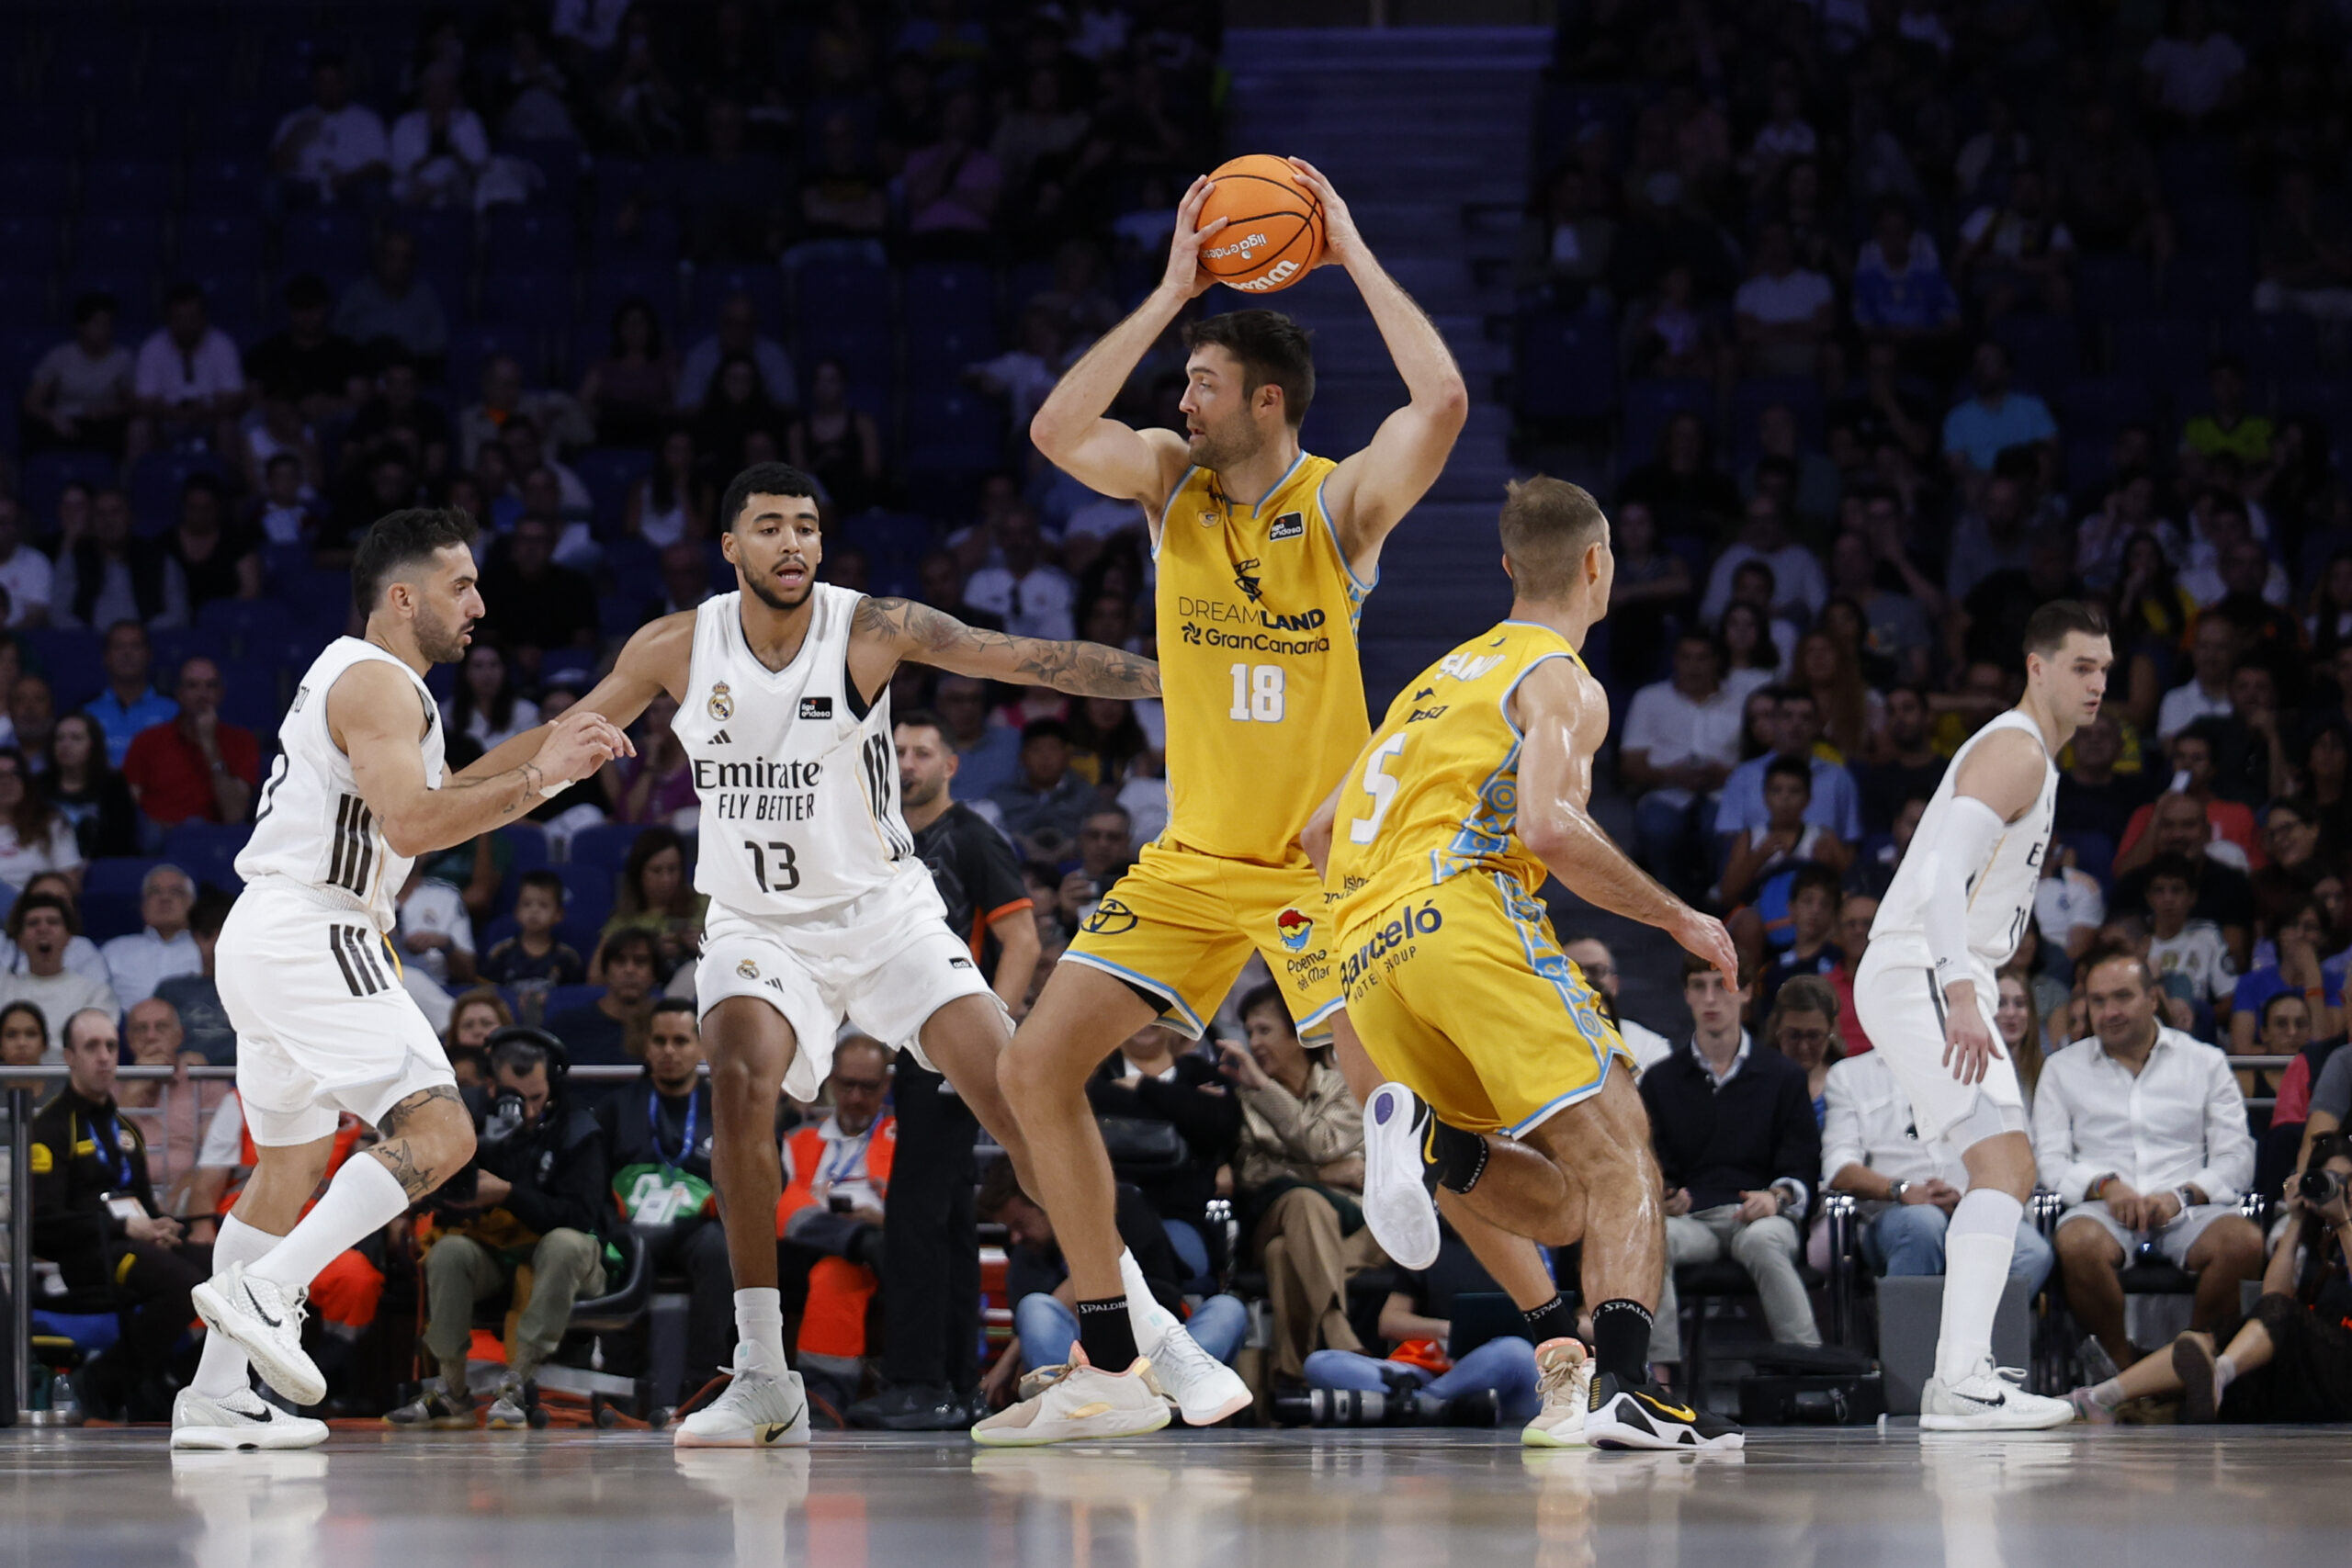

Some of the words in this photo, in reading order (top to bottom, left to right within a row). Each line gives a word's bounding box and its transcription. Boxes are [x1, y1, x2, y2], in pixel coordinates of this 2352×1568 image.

[1239, 232, 1268, 253] liga
[1218, 258, 1300, 290] Wilso
[1179, 595, 1326, 631] DREAMLAND
[1204, 628, 1330, 655] GranCanaria
[1229, 662, 1285, 724] 18
[693, 756, 824, 790] Emirate
[1350, 731, 1408, 845] 5
[718, 794, 750, 819] FLY
[755, 793, 815, 821] BETTER
[744, 840, 800, 894] 13
[1286, 949, 1328, 976] Poema
[1308, 964, 1331, 985] Mar
